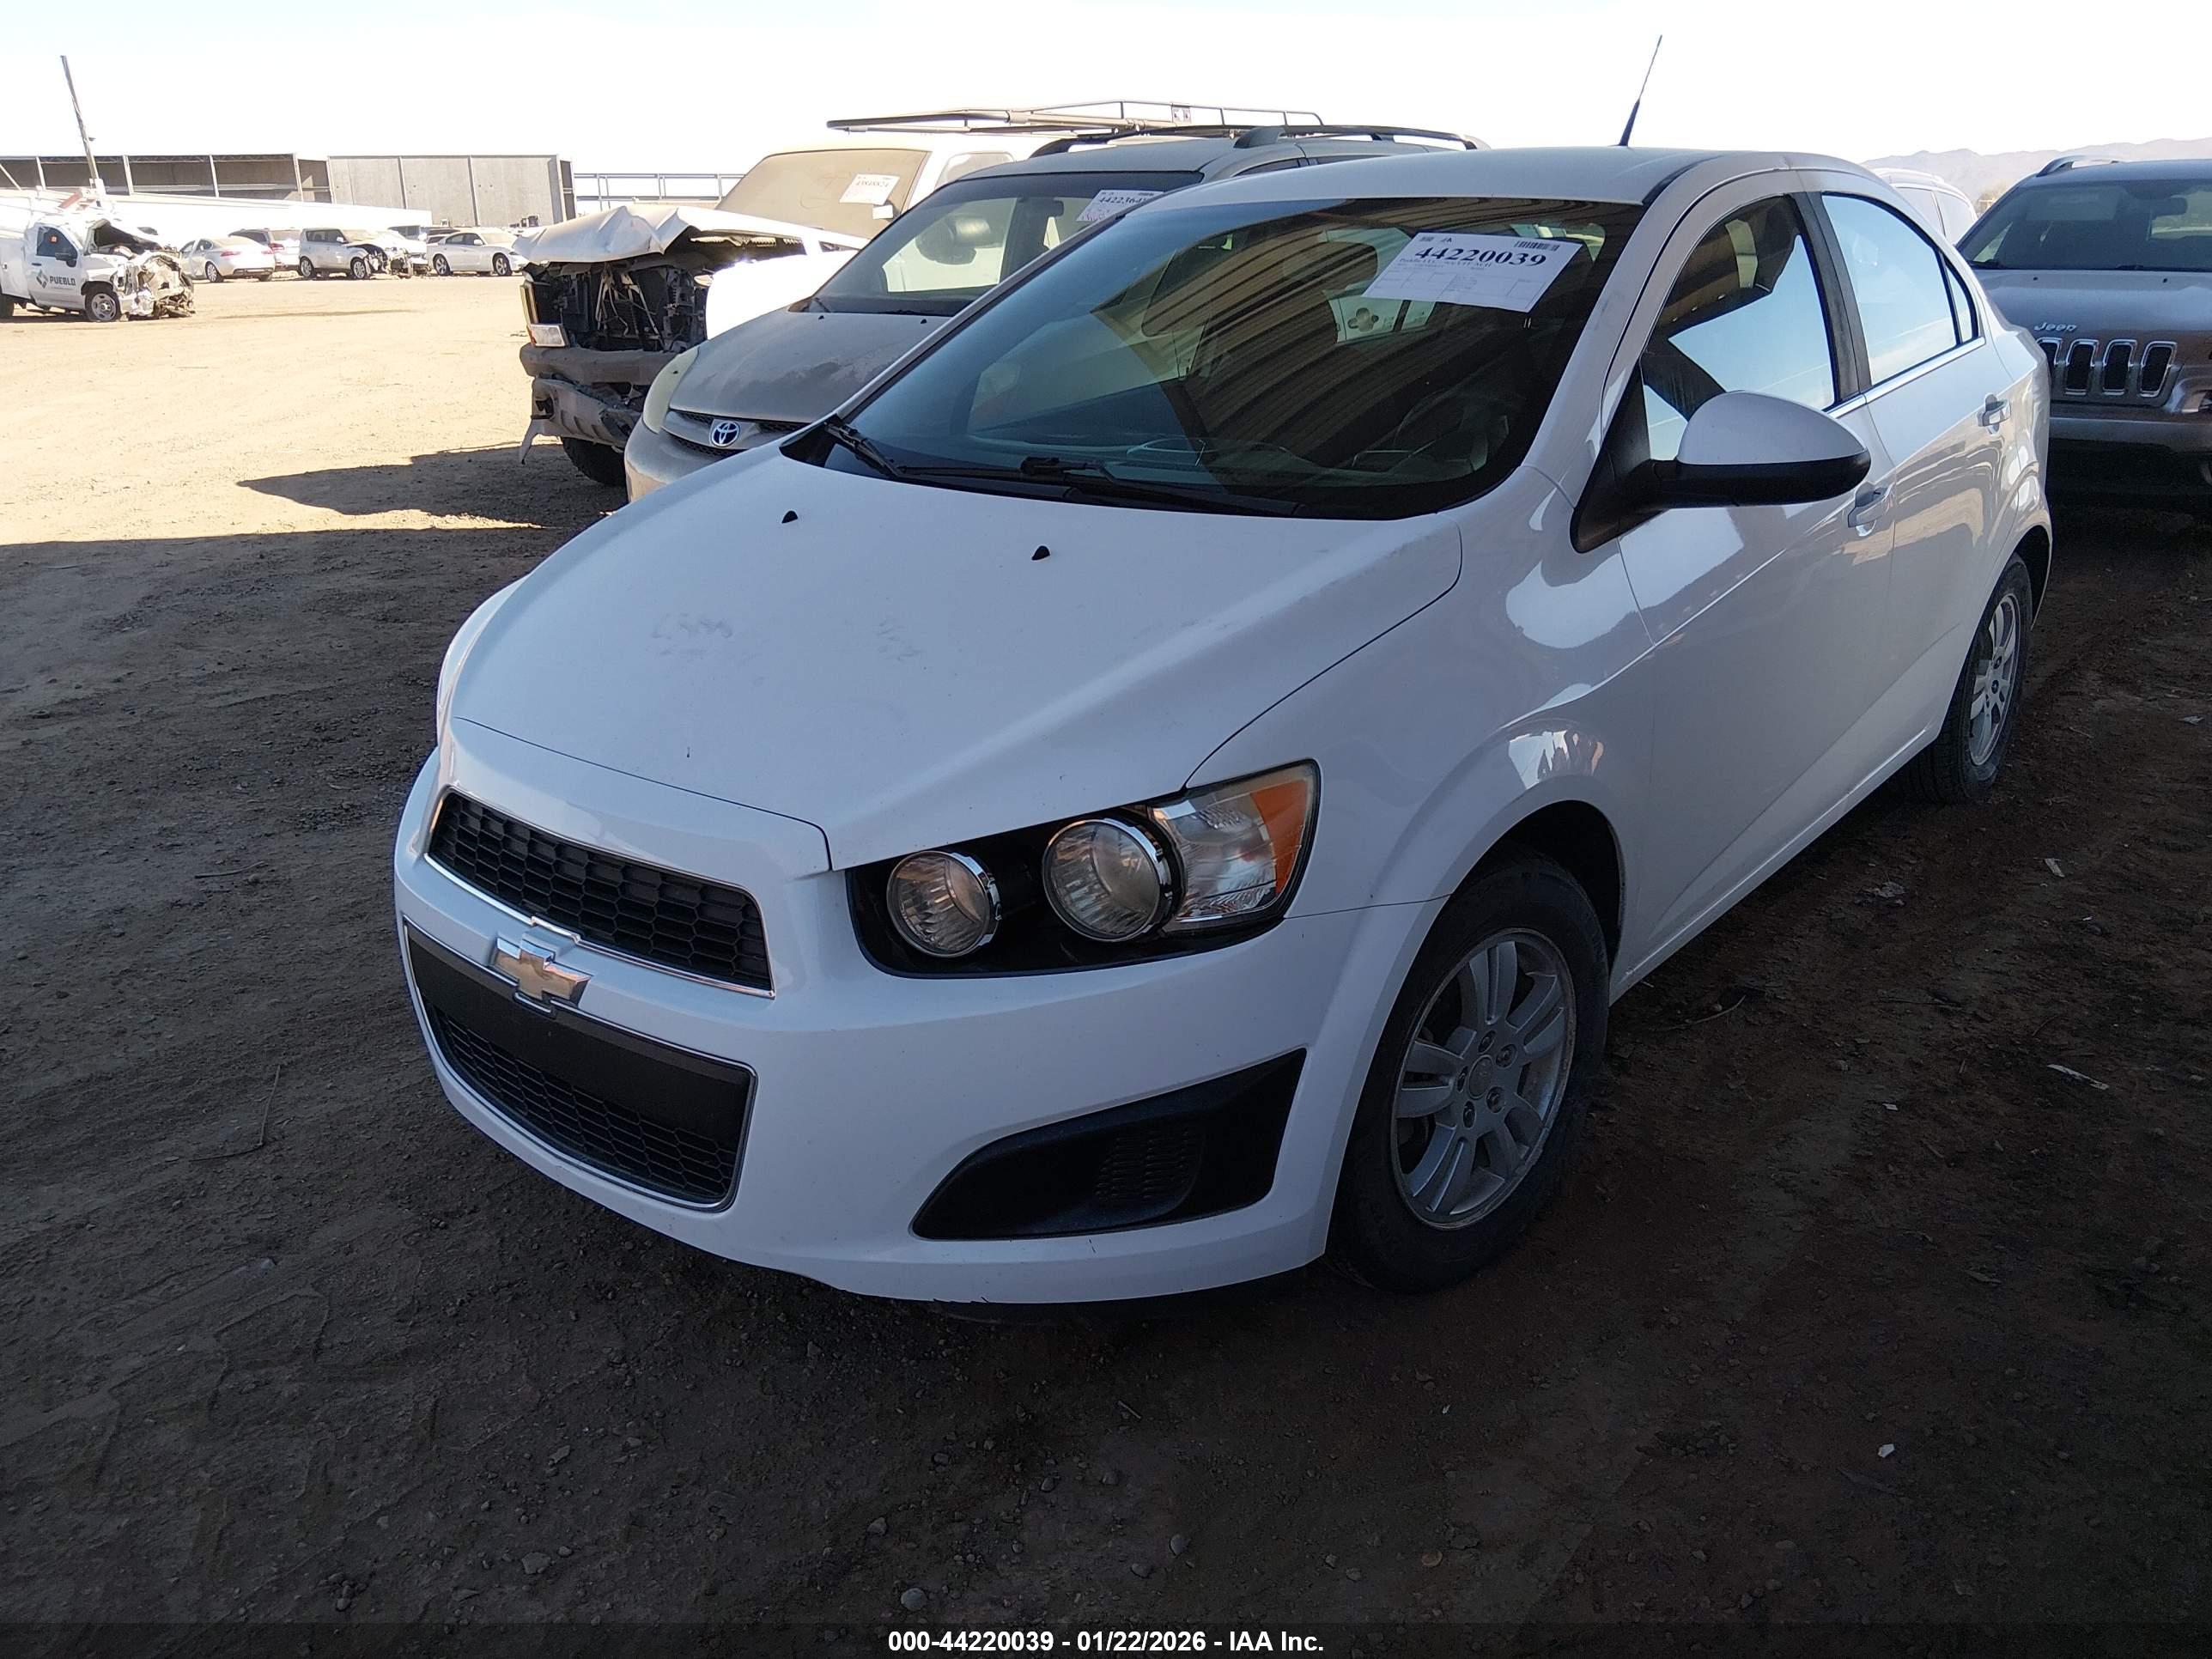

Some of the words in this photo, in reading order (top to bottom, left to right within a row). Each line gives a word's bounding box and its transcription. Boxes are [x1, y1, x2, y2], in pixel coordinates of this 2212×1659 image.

[1415, 246, 1547, 268] 44220039
[49, 275, 76, 286] PUEBLO
[2033, 322, 2078, 333] Jeep
